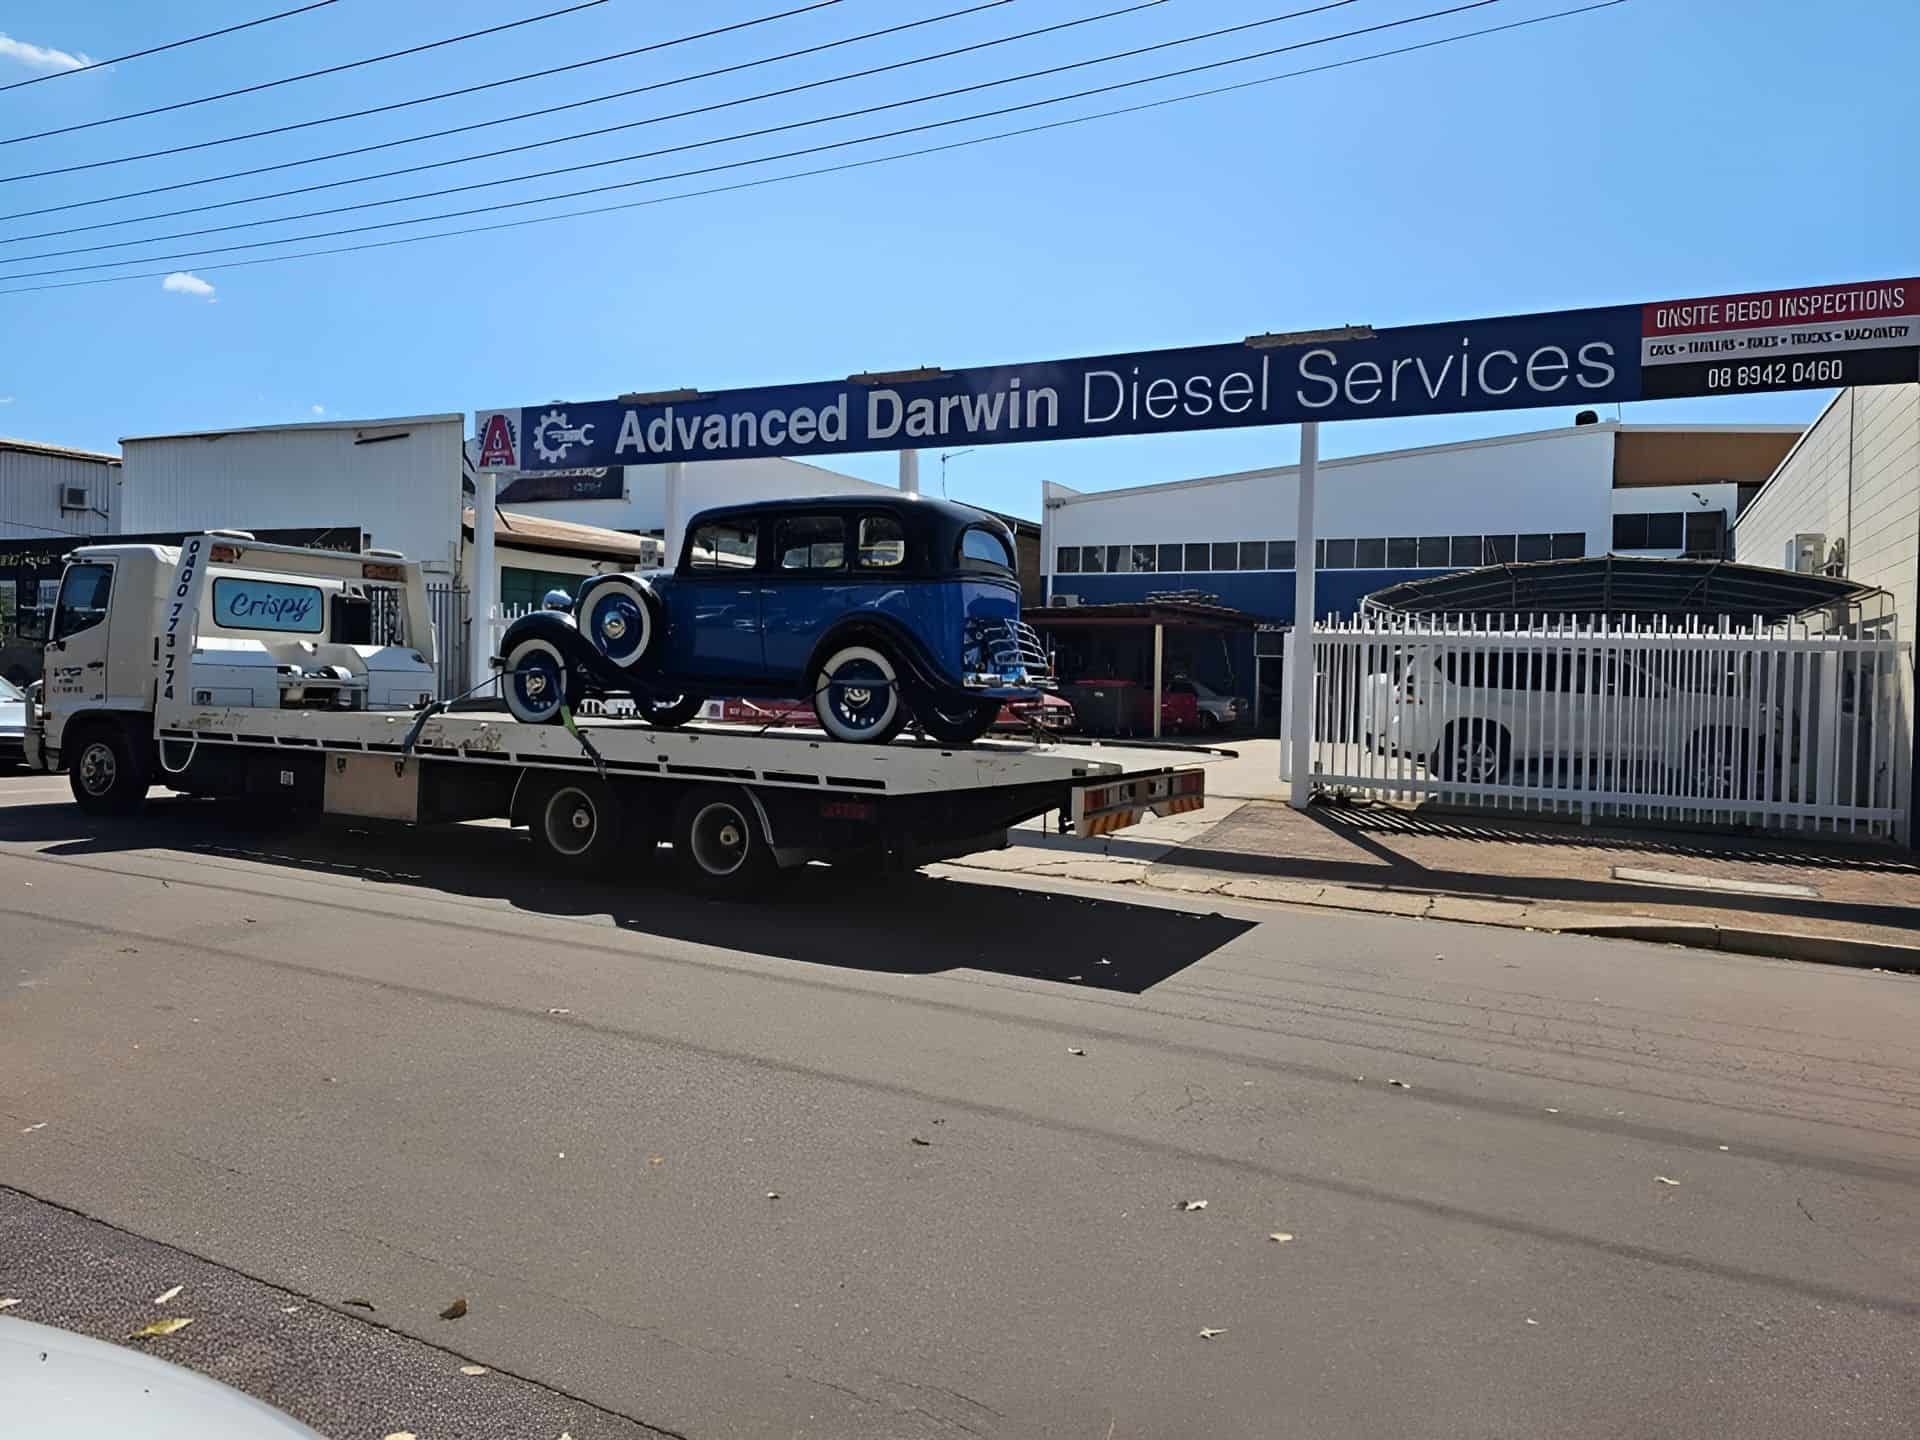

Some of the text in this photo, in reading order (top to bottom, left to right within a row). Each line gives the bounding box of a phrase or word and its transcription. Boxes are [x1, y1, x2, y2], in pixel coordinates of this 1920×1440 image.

[1656, 287, 1905, 329] ONSITE REGO INSPECTIONS
[1708, 360, 1842, 388] 08 8942 0460
[615, 337, 1616, 454] Advanced Darwin Diesel Services
[230, 592, 313, 622] Crispy
